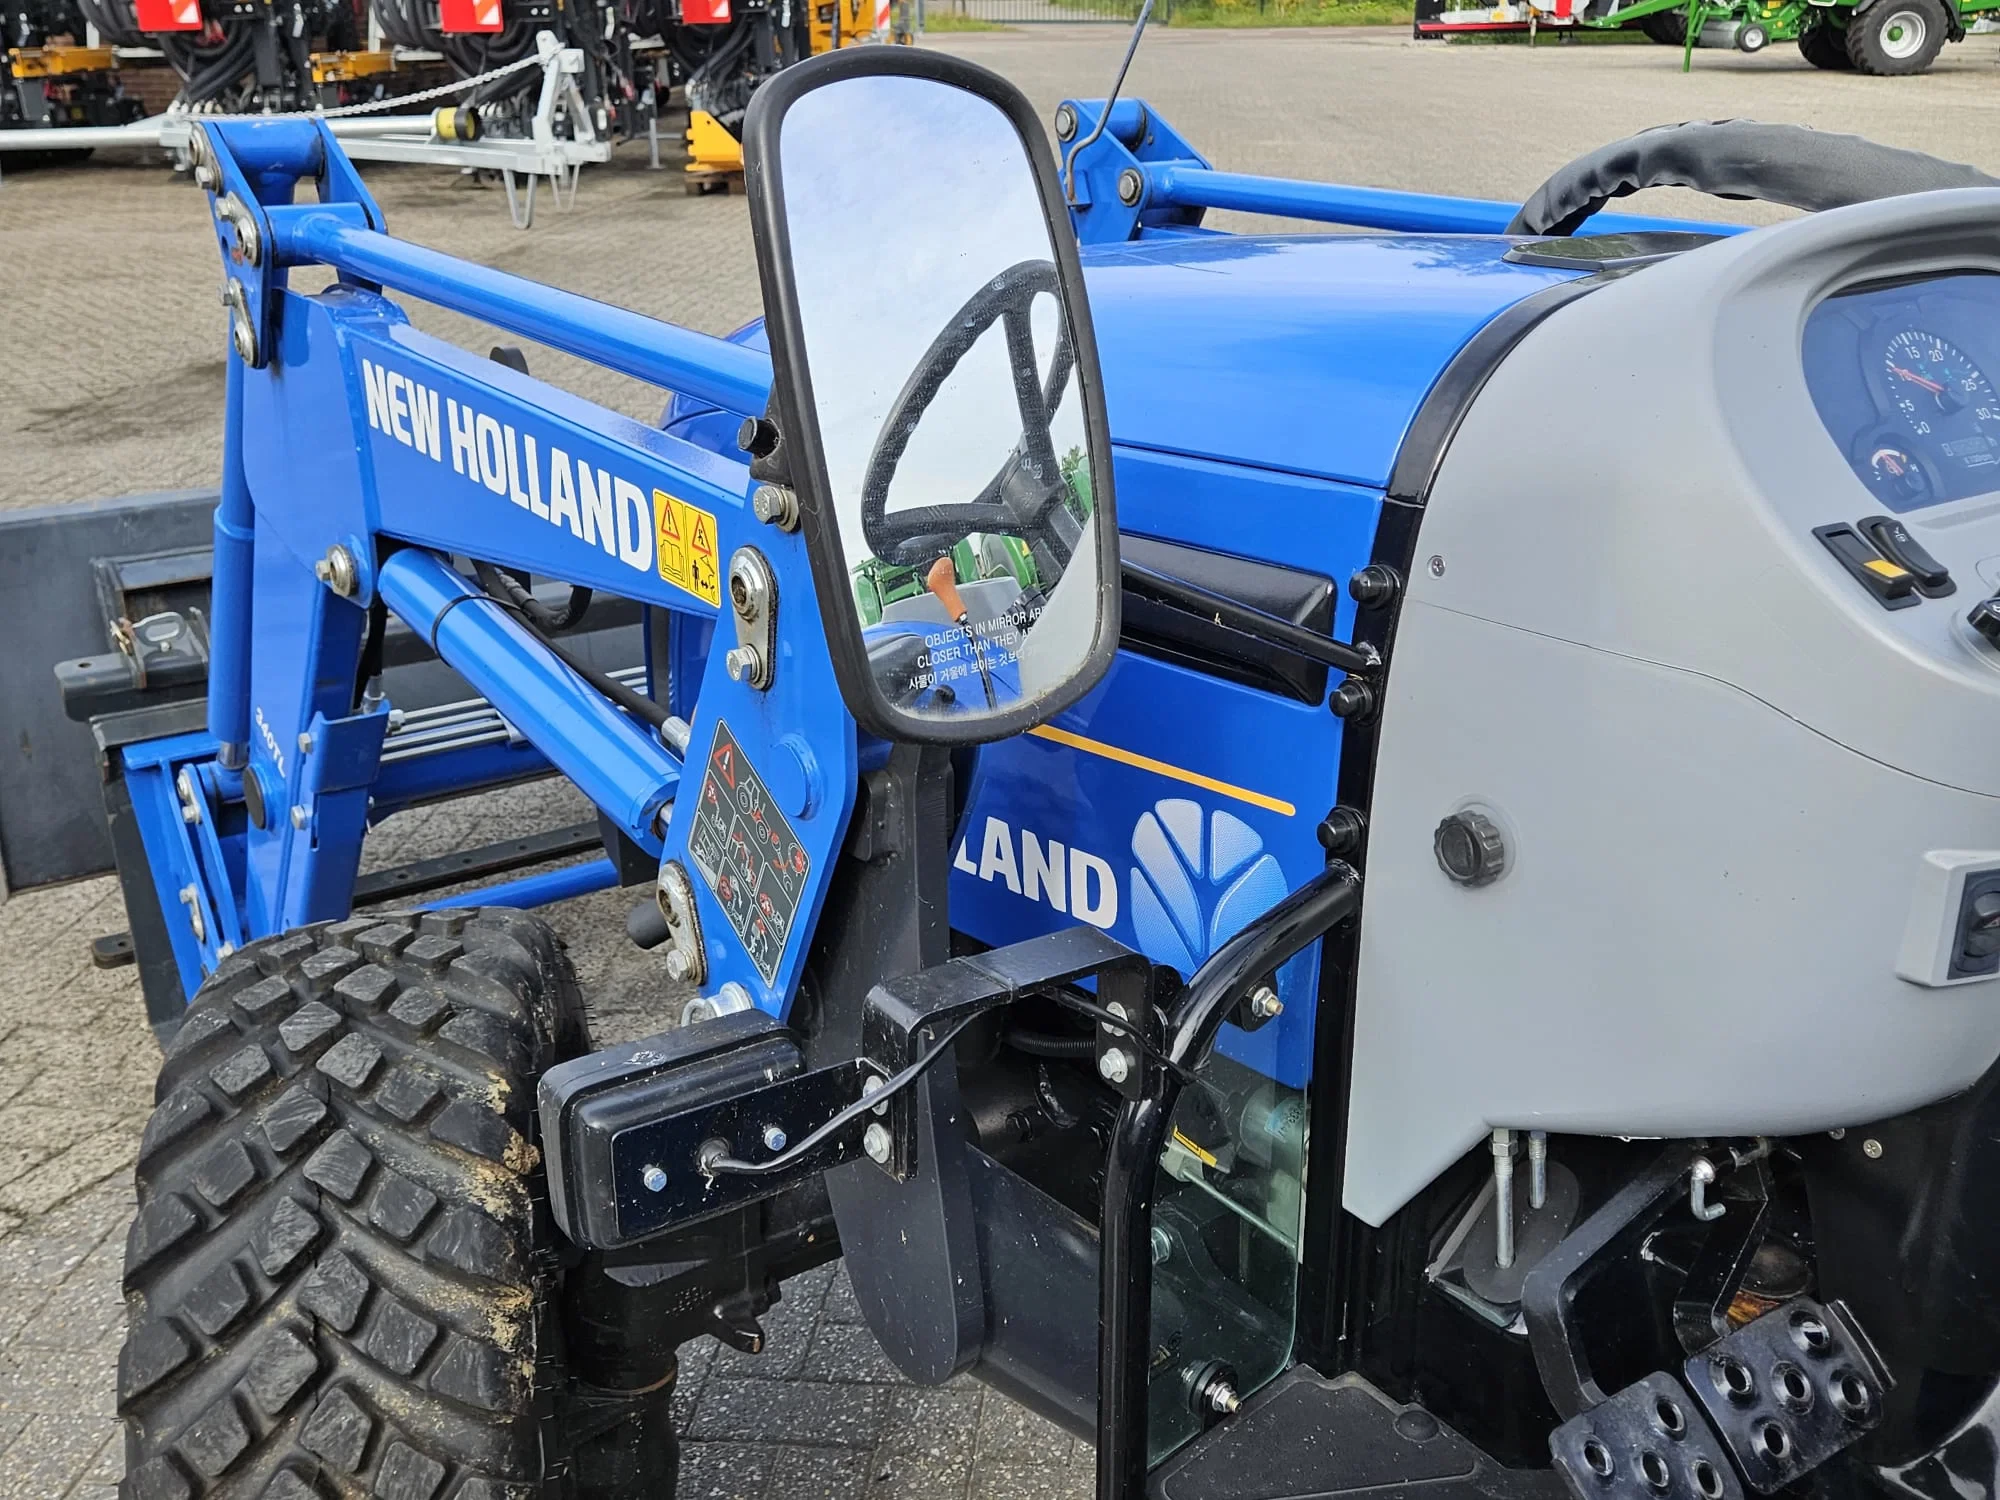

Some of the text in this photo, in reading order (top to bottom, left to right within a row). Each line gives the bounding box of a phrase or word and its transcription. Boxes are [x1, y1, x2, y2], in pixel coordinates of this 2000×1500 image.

[1904, 346, 1920, 359] 15
[1929, 349, 1944, 361] 20
[1961, 378, 1977, 391] 25
[1904, 399, 1915, 412] 5
[1976, 407, 1992, 420] 30
[1920, 421, 1931, 434] 0
[362, 358, 653, 573] NEW HOLLAND
[924, 625, 973, 648] OBJECTS
[975, 621, 986, 636] IN
[988, 611, 1027, 632] MIRROR
[917, 646, 961, 669] CLOSER
[963, 637, 991, 656] THAN
[993, 631, 1018, 648] THEY
[908, 672, 938, 690] 사물이
[939, 664, 968, 682] 거울에
[970, 657, 997, 675] 보이는
[255, 706, 287, 779] 340TL
